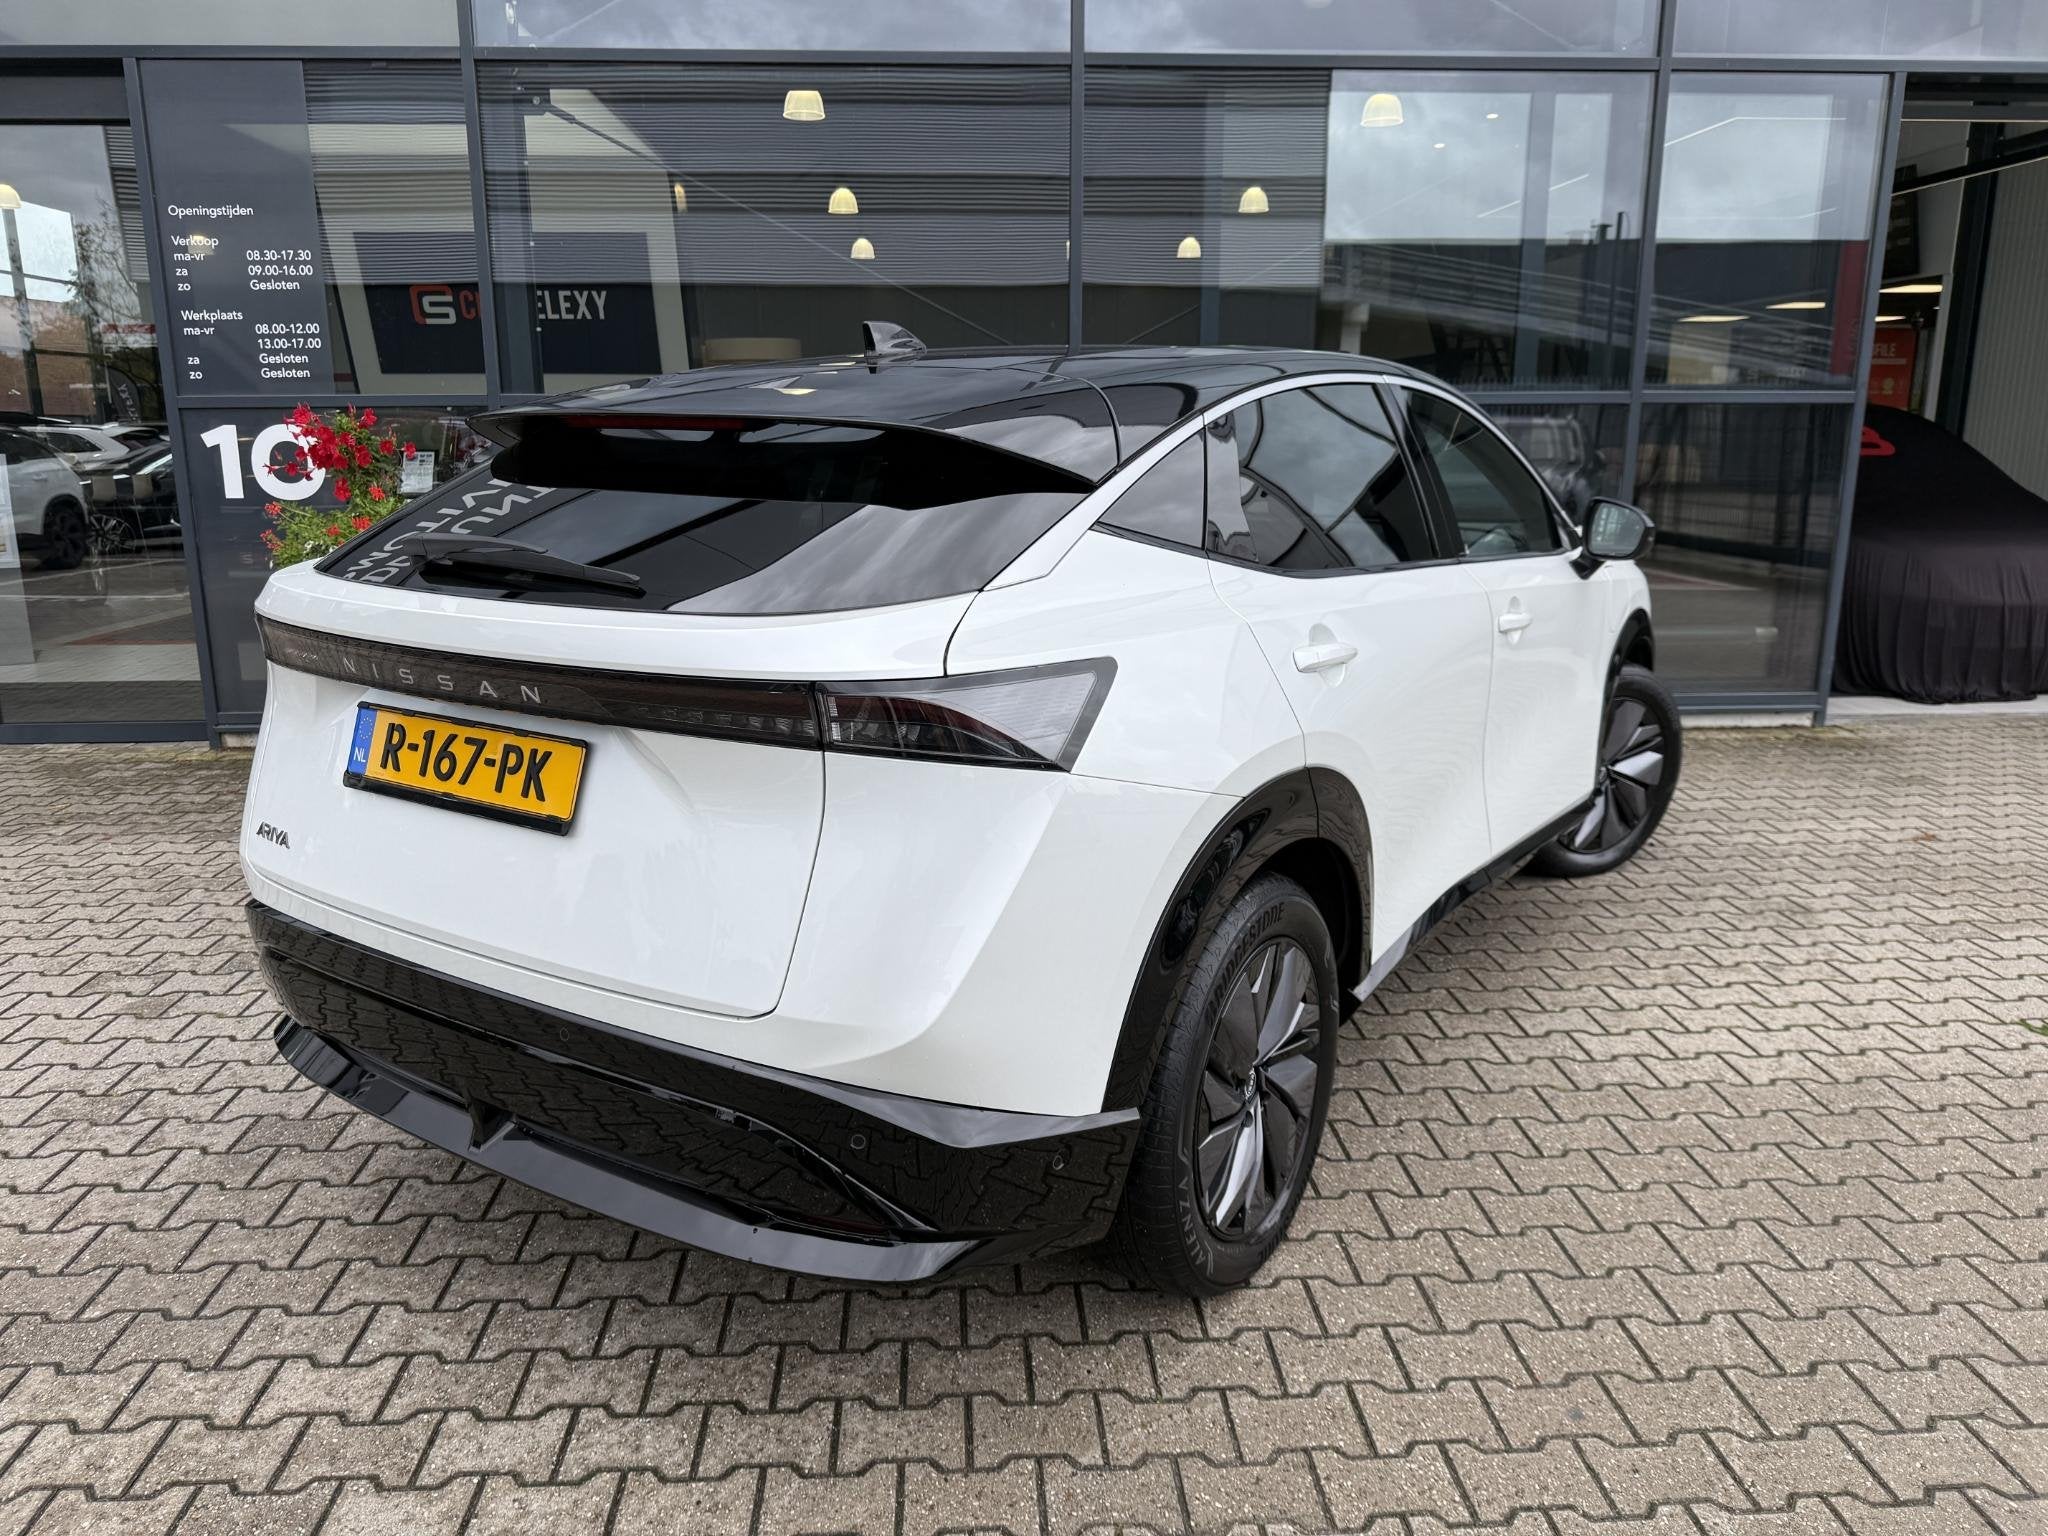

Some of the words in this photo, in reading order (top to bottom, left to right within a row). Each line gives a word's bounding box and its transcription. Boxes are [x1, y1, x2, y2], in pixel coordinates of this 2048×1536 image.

[167, 204, 254, 219] Openingstijden
[171, 234, 219, 248] Verkoop
[173, 252, 206, 261] ma-vr
[246, 249, 312, 261] 08.30-17.30
[175, 266, 188, 276] za
[247, 265, 313, 276] 09.00-16.00
[177, 282, 191, 291] zo
[250, 279, 301, 290] Gesloten
[180, 309, 244, 323] Werkplaats
[183, 327, 215, 336] ma-vr
[255, 323, 320, 335] 08.00-12.00
[257, 338, 322, 349] 13.00-17.00
[187, 356, 200, 365] za
[259, 352, 309, 364] Gesloten
[189, 371, 203, 380] zo
[261, 367, 311, 379] Gesloten
[200, 423, 326, 500] 10
[343, 656, 541, 704] NISSAN
[353, 746, 367, 763] NL
[379, 722, 553, 803] R-167-PK
[256, 821, 290, 849] ARIYA
